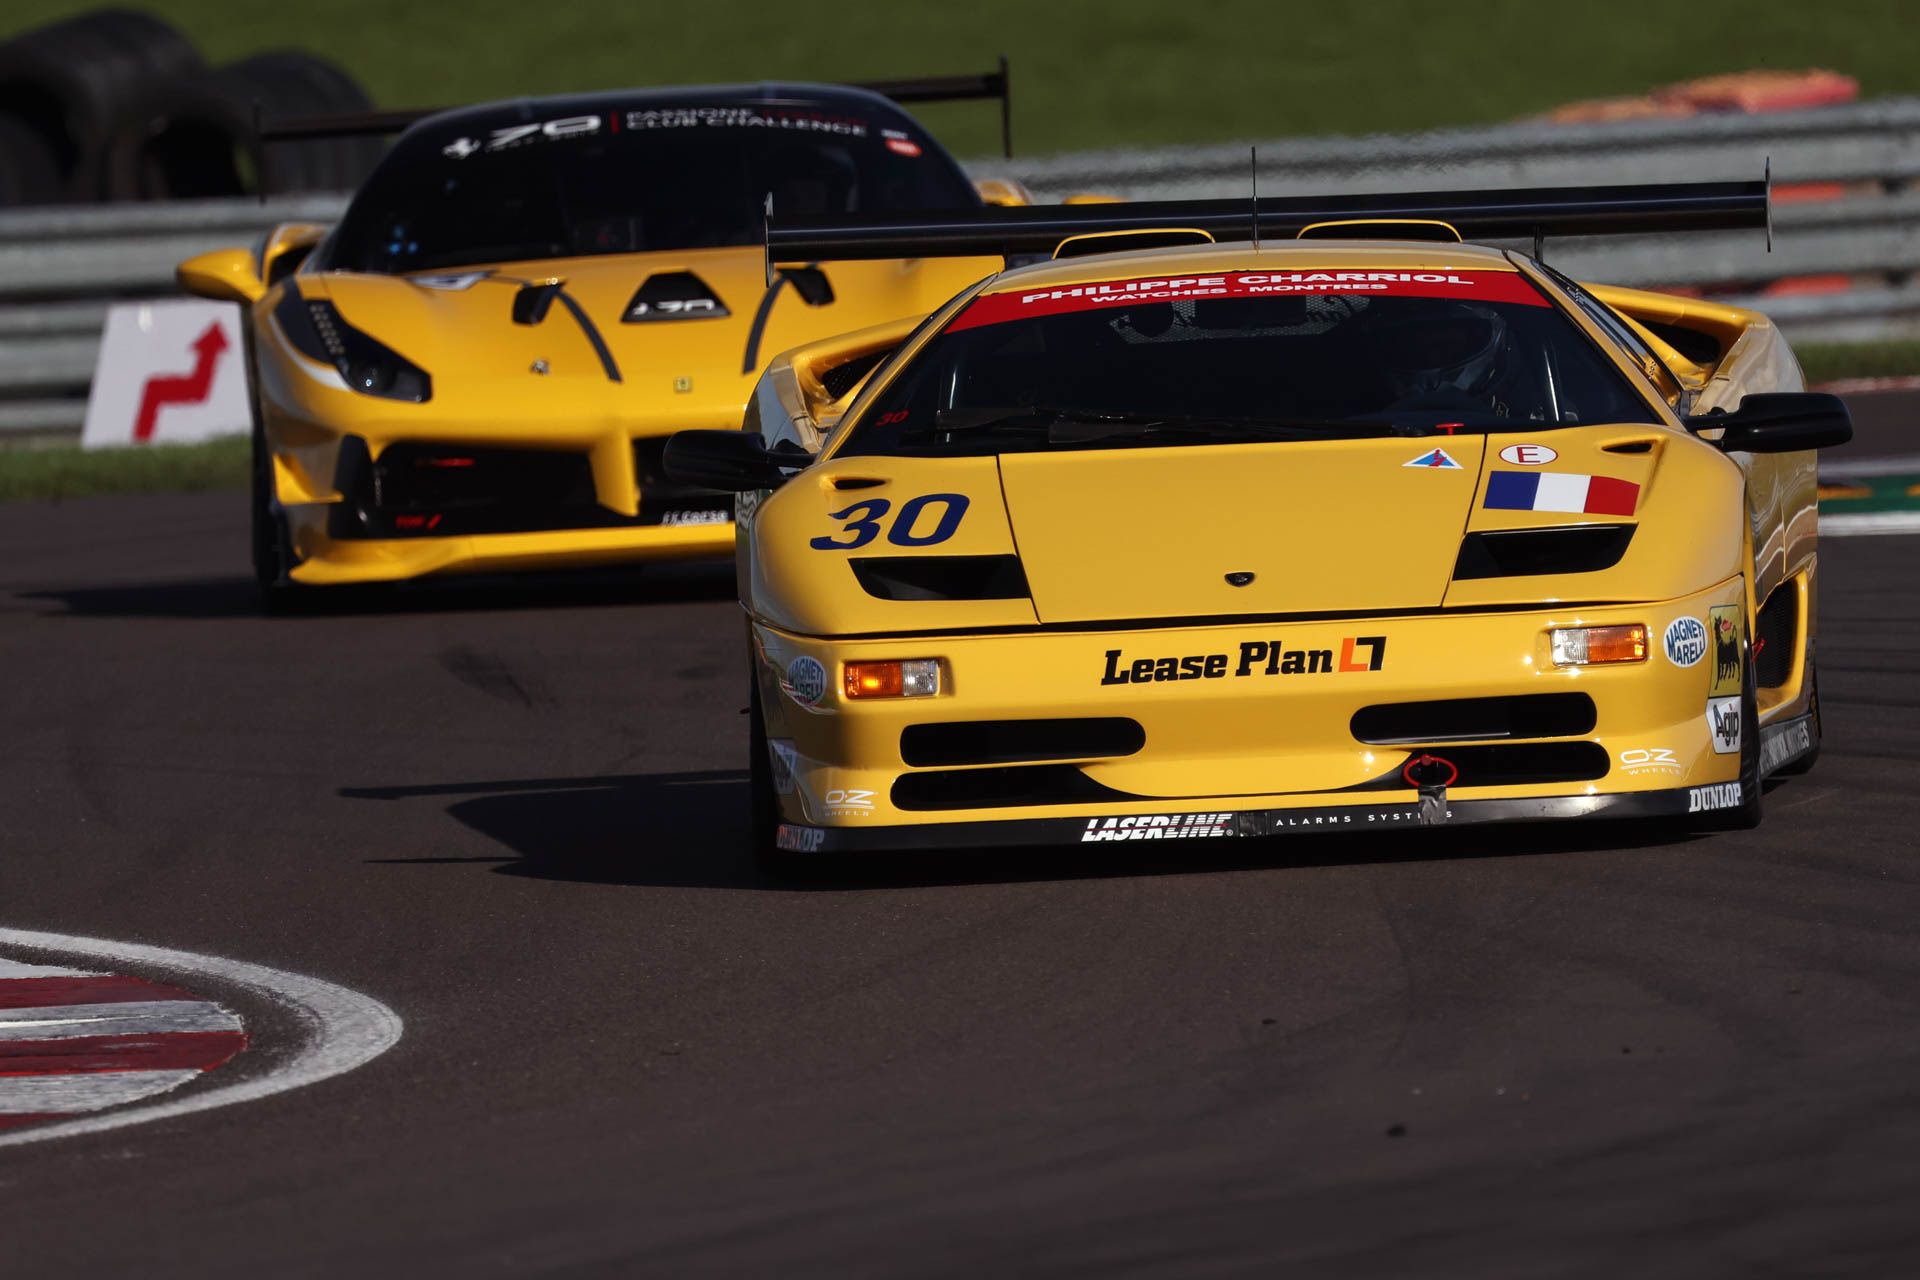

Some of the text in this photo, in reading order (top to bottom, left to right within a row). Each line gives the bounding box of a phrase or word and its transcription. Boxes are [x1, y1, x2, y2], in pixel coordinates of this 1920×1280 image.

[626, 117, 698, 130] CLUB
[706, 116, 867, 137] CHALLENGE
[1022, 273, 1475, 304] PHILIPPE CHARRIOL
[1091, 287, 1227, 303] WATCHES
[1249, 284, 1388, 293] MONTRES
[875, 409, 910, 427] 30
[1516, 446, 1541, 464] E
[810, 493, 971, 550] 30
[1666, 619, 1706, 649] MAGNETI
[1100, 640, 1333, 686] Lease Plan
[1668, 643, 1706, 666] MARELLI
[1713, 703, 1739, 747] Agip
[1688, 783, 1741, 813] DUNLOP
[1276, 815, 1352, 827] ALARMS
[1368, 811, 1453, 822] SYSTS
